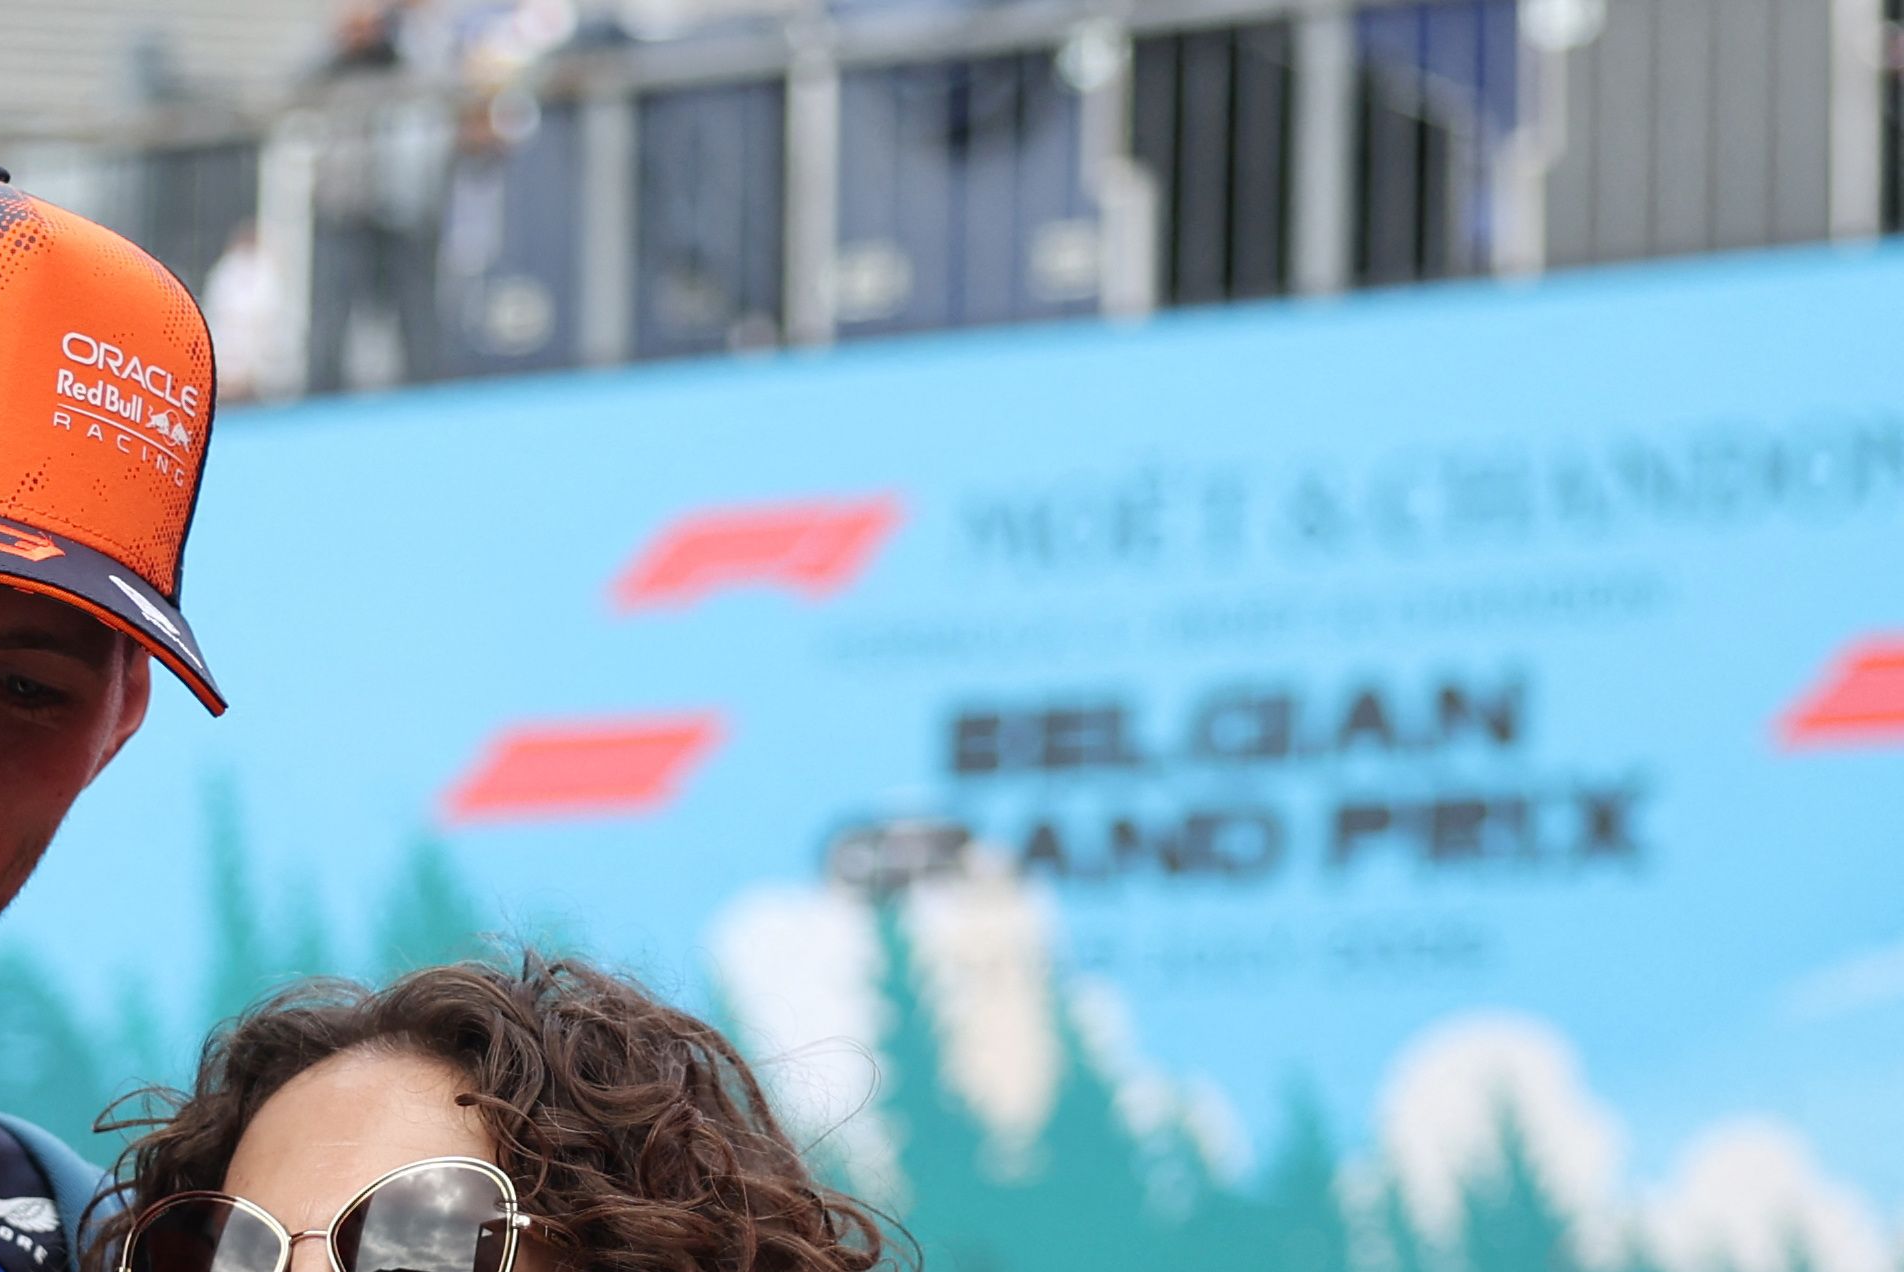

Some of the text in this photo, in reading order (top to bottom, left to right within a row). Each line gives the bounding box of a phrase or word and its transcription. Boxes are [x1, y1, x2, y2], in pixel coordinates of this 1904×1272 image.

[61, 331, 199, 418] ORACLE
[52, 411, 185, 488] RACING
[942, 668, 1534, 778] BELGIAN
